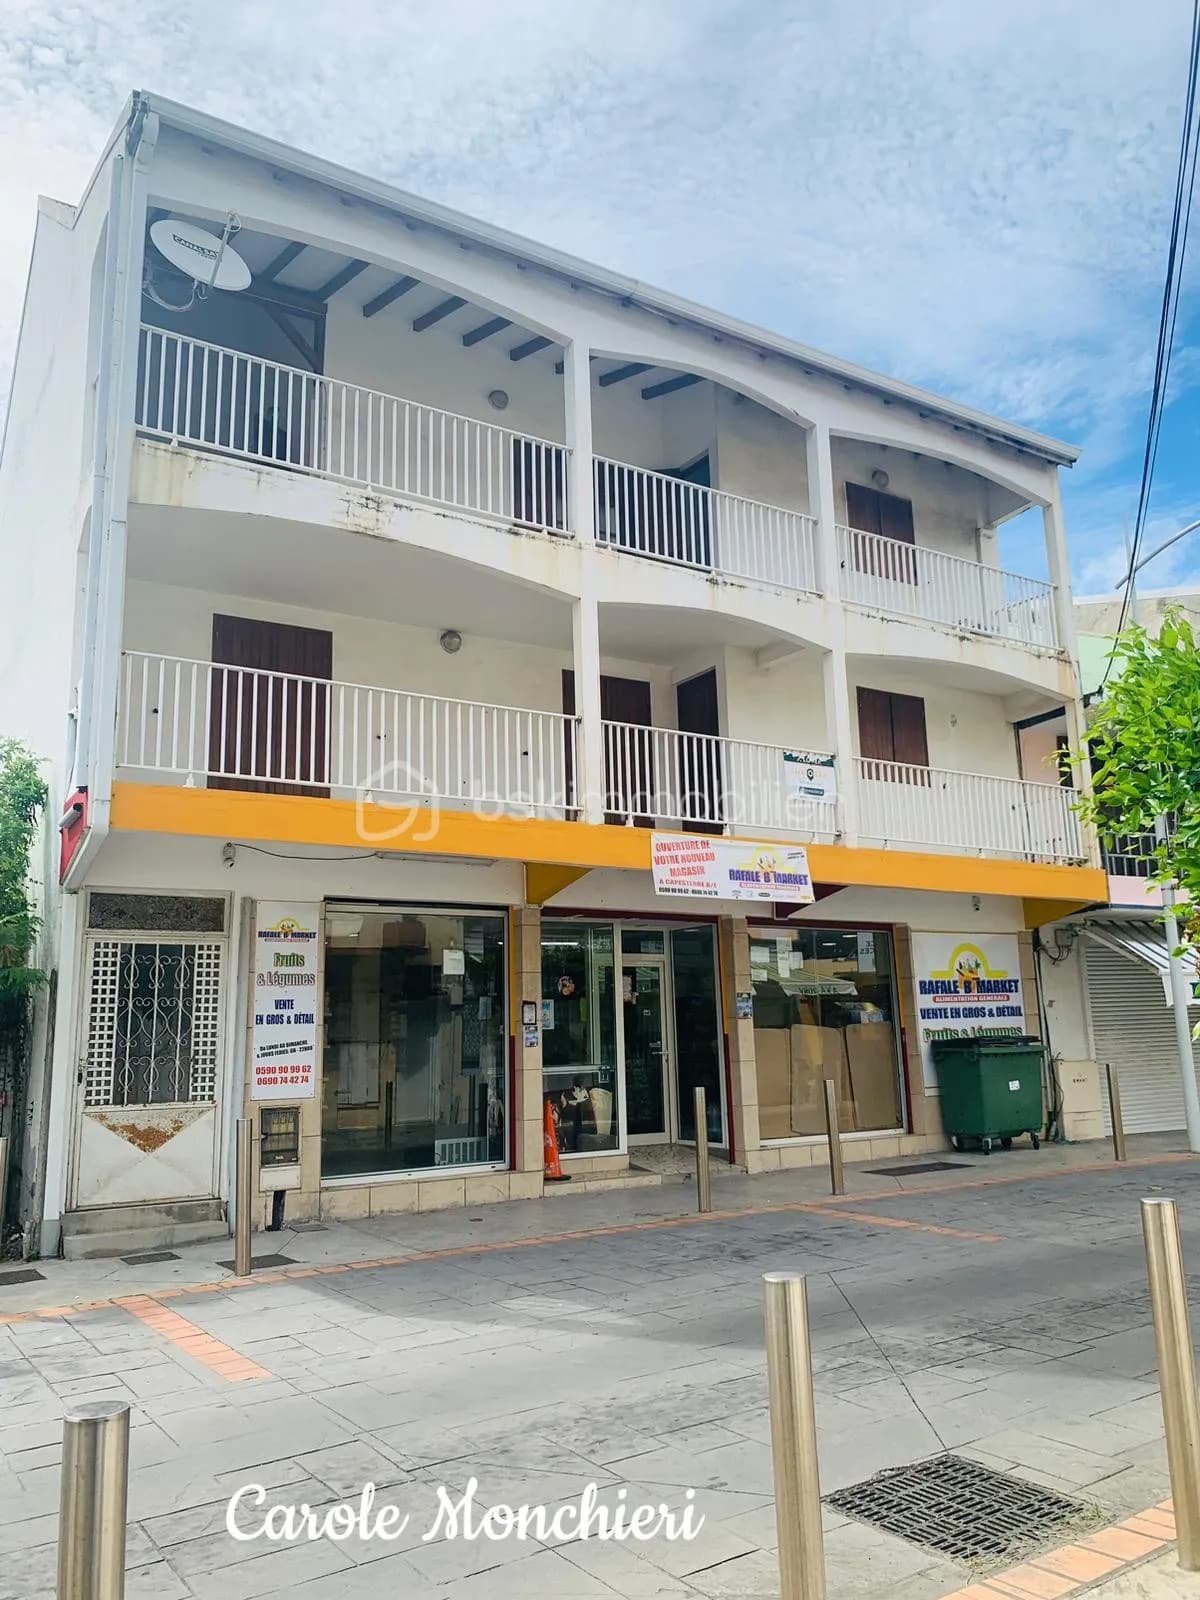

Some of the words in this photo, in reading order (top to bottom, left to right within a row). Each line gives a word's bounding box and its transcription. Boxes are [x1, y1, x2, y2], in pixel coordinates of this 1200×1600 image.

[655, 841, 700, 852] OUVERTURE
[701, 839, 711, 849] DE
[654, 854, 680, 865] VOTRE
[681, 852, 716, 864] NOUVEAU
[669, 866, 706, 877] MAGASIN
[728, 868, 761, 882] RAFALE
[763, 871, 771, 883] B
[773, 872, 809, 885] MARKET
[665, 879, 704, 887] CAPESTERRE
[273, 952, 305, 967] Fruits
[256, 973, 265, 986] &
[267, 971, 315, 987] Légumes
[919, 979, 960, 995] RAFALE
[963, 980, 972, 994] B
[975, 979, 1020, 993] MARKET
[274, 999, 295, 1010] VENTE
[255, 1014, 264, 1025] EN
[266, 1014, 285, 1025] GROS
[286, 1015, 292, 1024] &
[293, 1012, 315, 1024] DÉTAIL
[920, 1007, 949, 1020] VENTE
[950, 1007, 961, 1019] EN
[962, 1006, 986, 1018] GROS
[988, 1007, 995, 1017] &
[995, 1004, 1023, 1017] DÉTAIL
[923, 1028, 959, 1042] Fruits
[960, 1028, 970, 1039] &
[285, 1040, 308, 1048] DIMANCHE
[260, 1050, 274, 1058] JOURS
[255, 1067, 276, 1075] 0590
[278, 1066, 289, 1074] 90
[290, 1065, 300, 1073] 99
[301, 1064, 312, 1073] 62
[257, 1077, 278, 1085] 0690
[279, 1076, 288, 1084] 74
[289, 1076, 299, 1084] 42
[300, 1075, 309, 1083] 74
